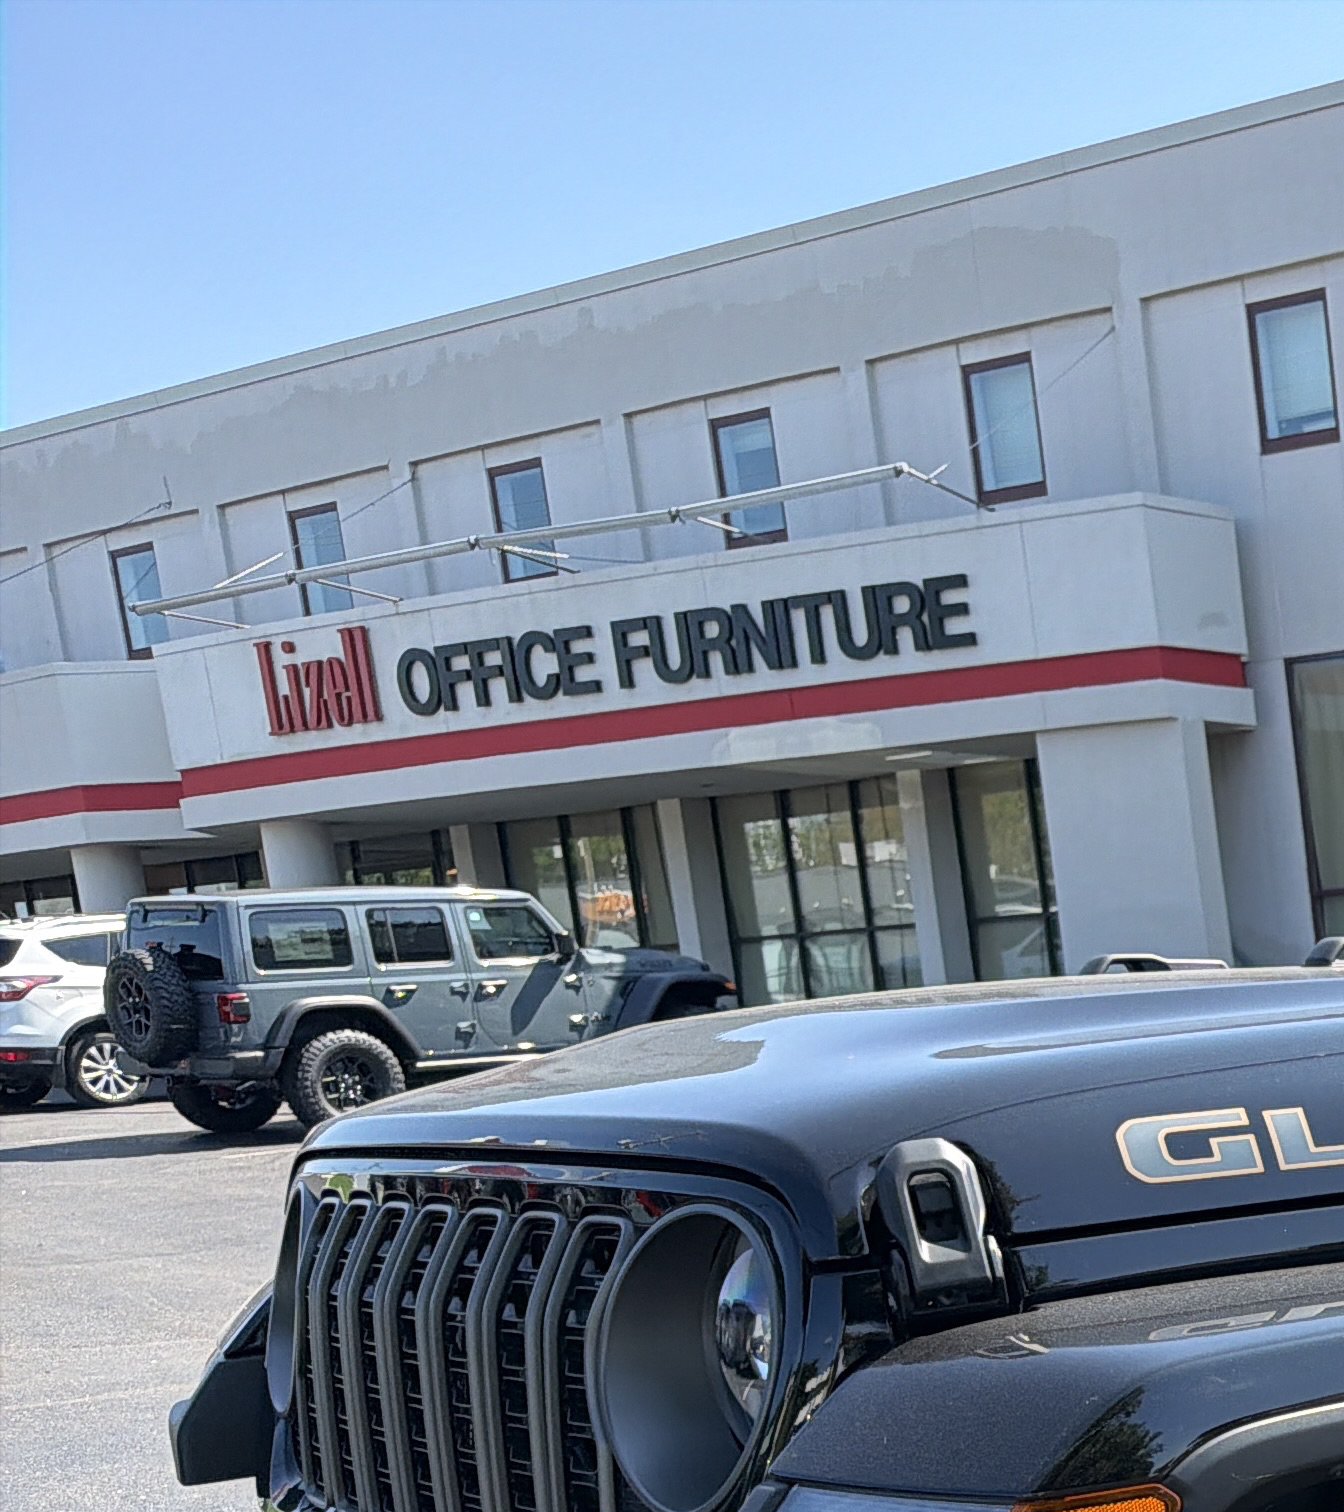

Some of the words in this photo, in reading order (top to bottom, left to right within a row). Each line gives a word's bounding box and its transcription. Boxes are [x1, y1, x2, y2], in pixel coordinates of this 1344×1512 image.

[253, 625, 384, 737] Lizell
[397, 624, 602, 718] OFFICE
[610, 573, 979, 690] FURNITURE
